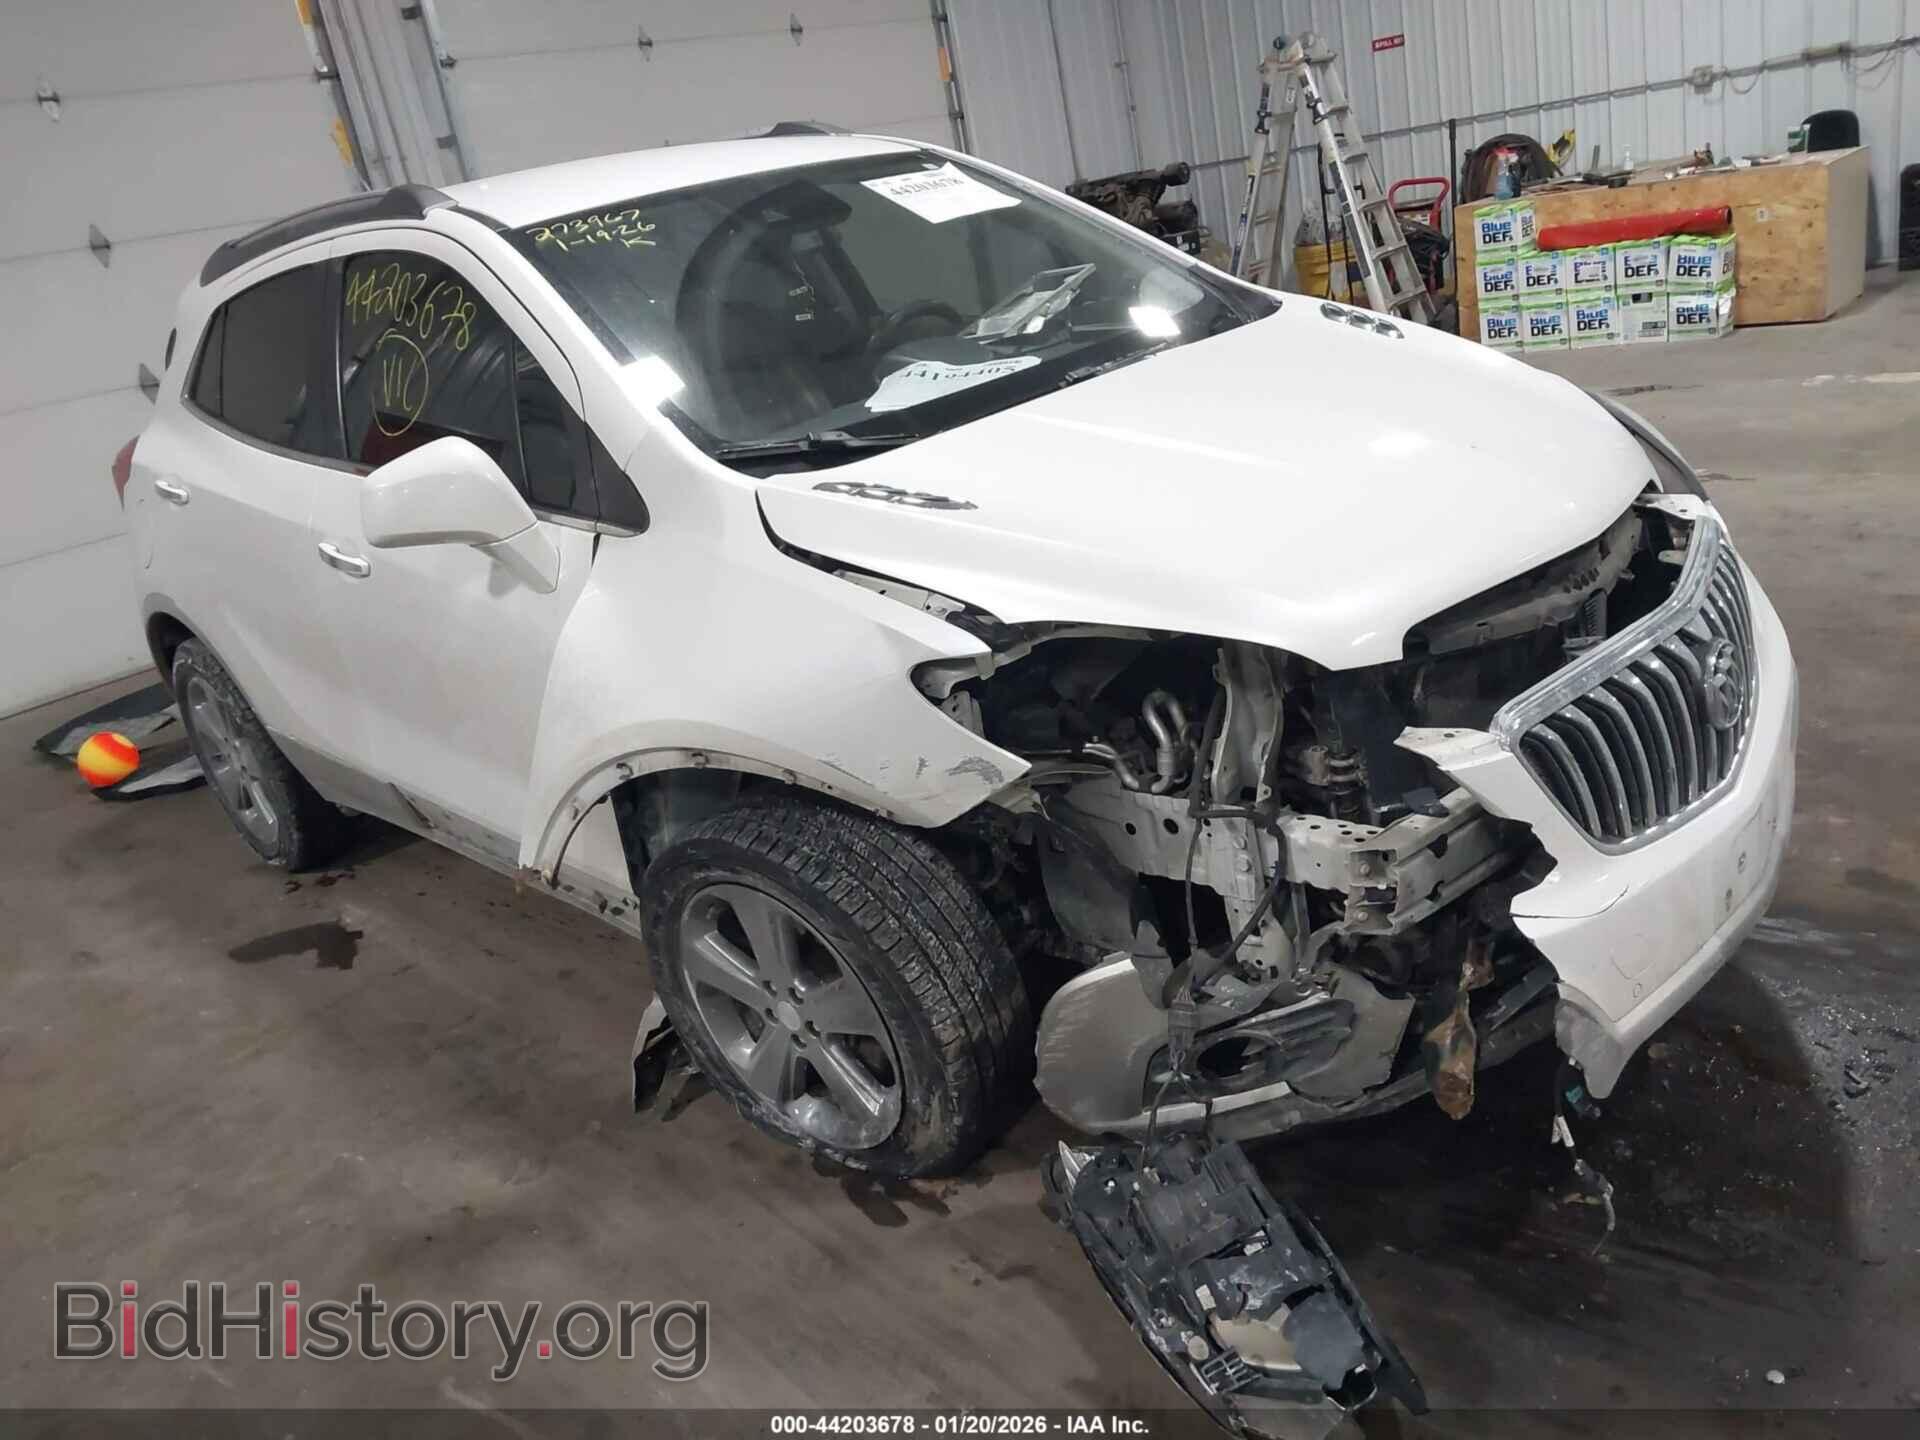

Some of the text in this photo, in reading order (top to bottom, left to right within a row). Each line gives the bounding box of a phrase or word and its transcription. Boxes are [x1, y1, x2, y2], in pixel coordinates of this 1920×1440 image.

[525, 209, 640, 242] 273967
[1481, 221, 1512, 233] Blue
[1482, 231, 1513, 244] DEF
[1624, 264, 1658, 278] DEF
[1676, 265, 1711, 277] DEF
[1484, 280, 1514, 293] DEF
[1526, 274, 1557, 287] DEF
[345, 262, 478, 351] 44203678
[1577, 318, 1609, 331] DEF
[1676, 313, 1710, 325] DEF
[1488, 327, 1518, 339] DEF
[1530, 324, 1562, 336] DEF
